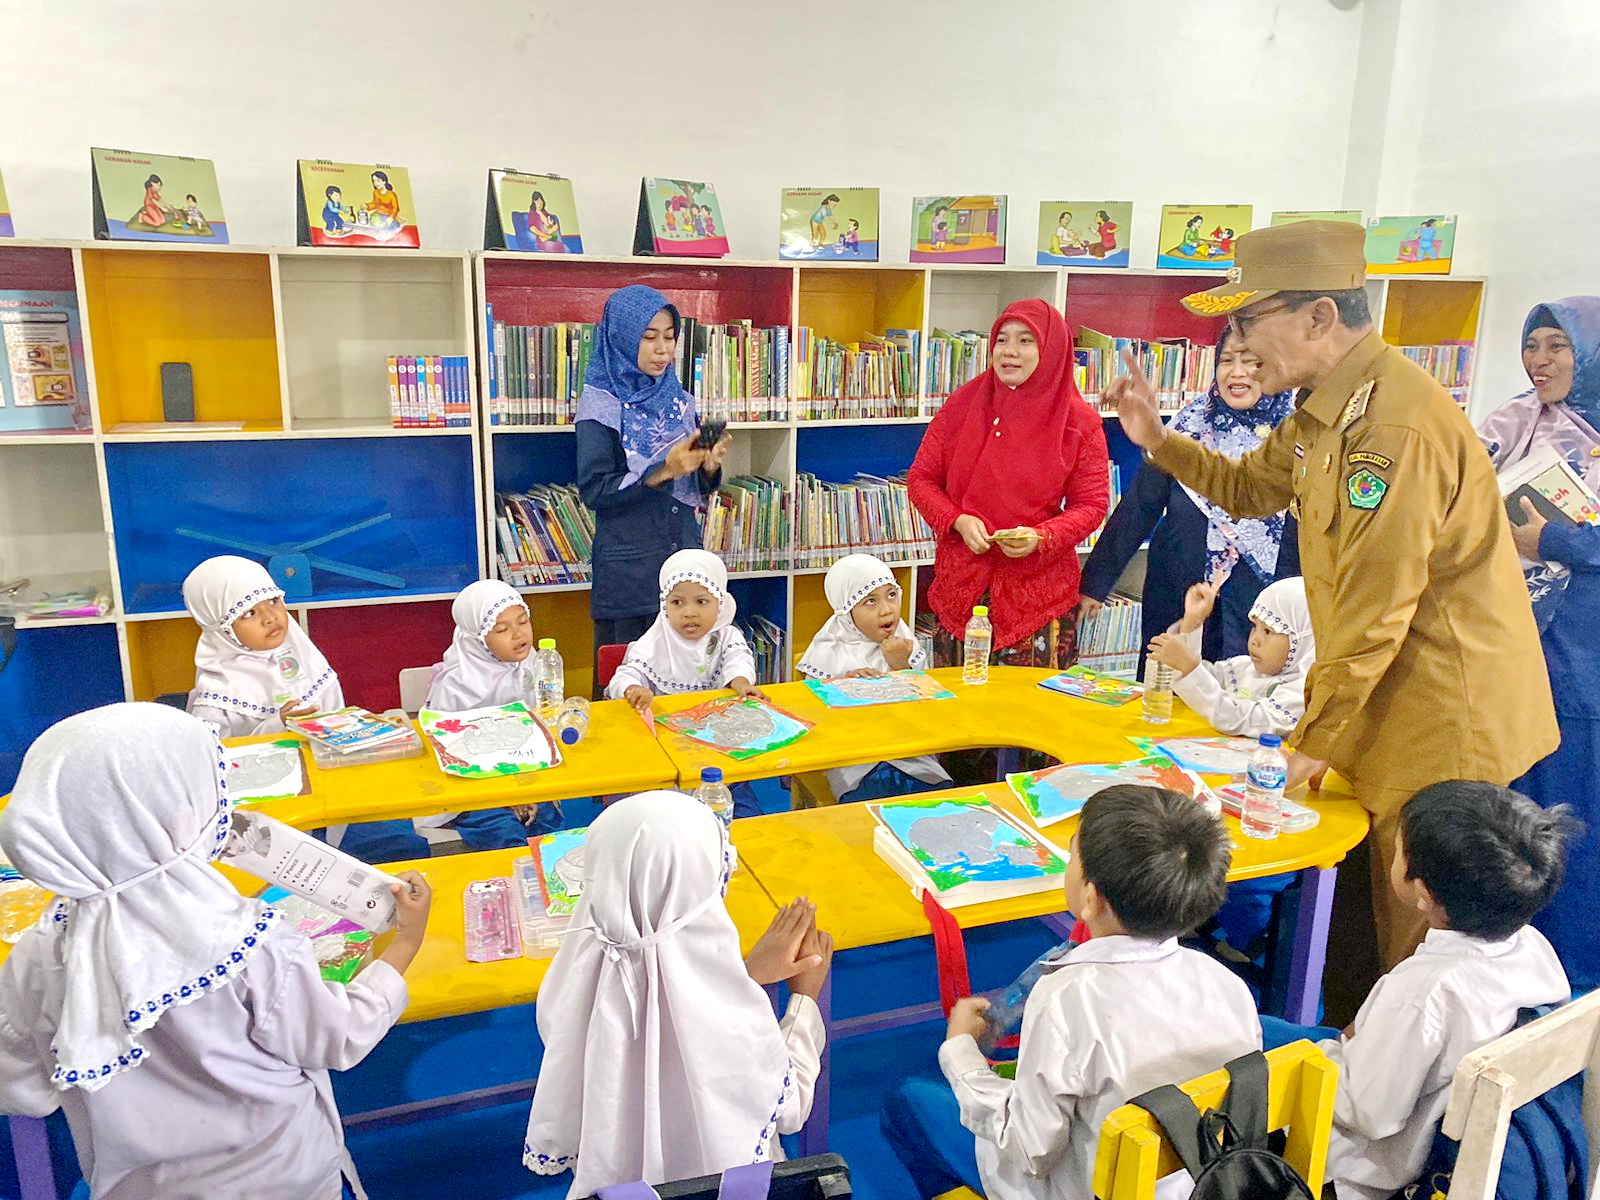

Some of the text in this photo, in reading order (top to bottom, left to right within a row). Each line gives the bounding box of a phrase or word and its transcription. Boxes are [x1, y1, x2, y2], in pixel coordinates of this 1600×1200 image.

[286, 858, 299, 875] Pencil
[294, 862, 309, 879] Eraser
[303, 858, 323, 883] Sharpener
